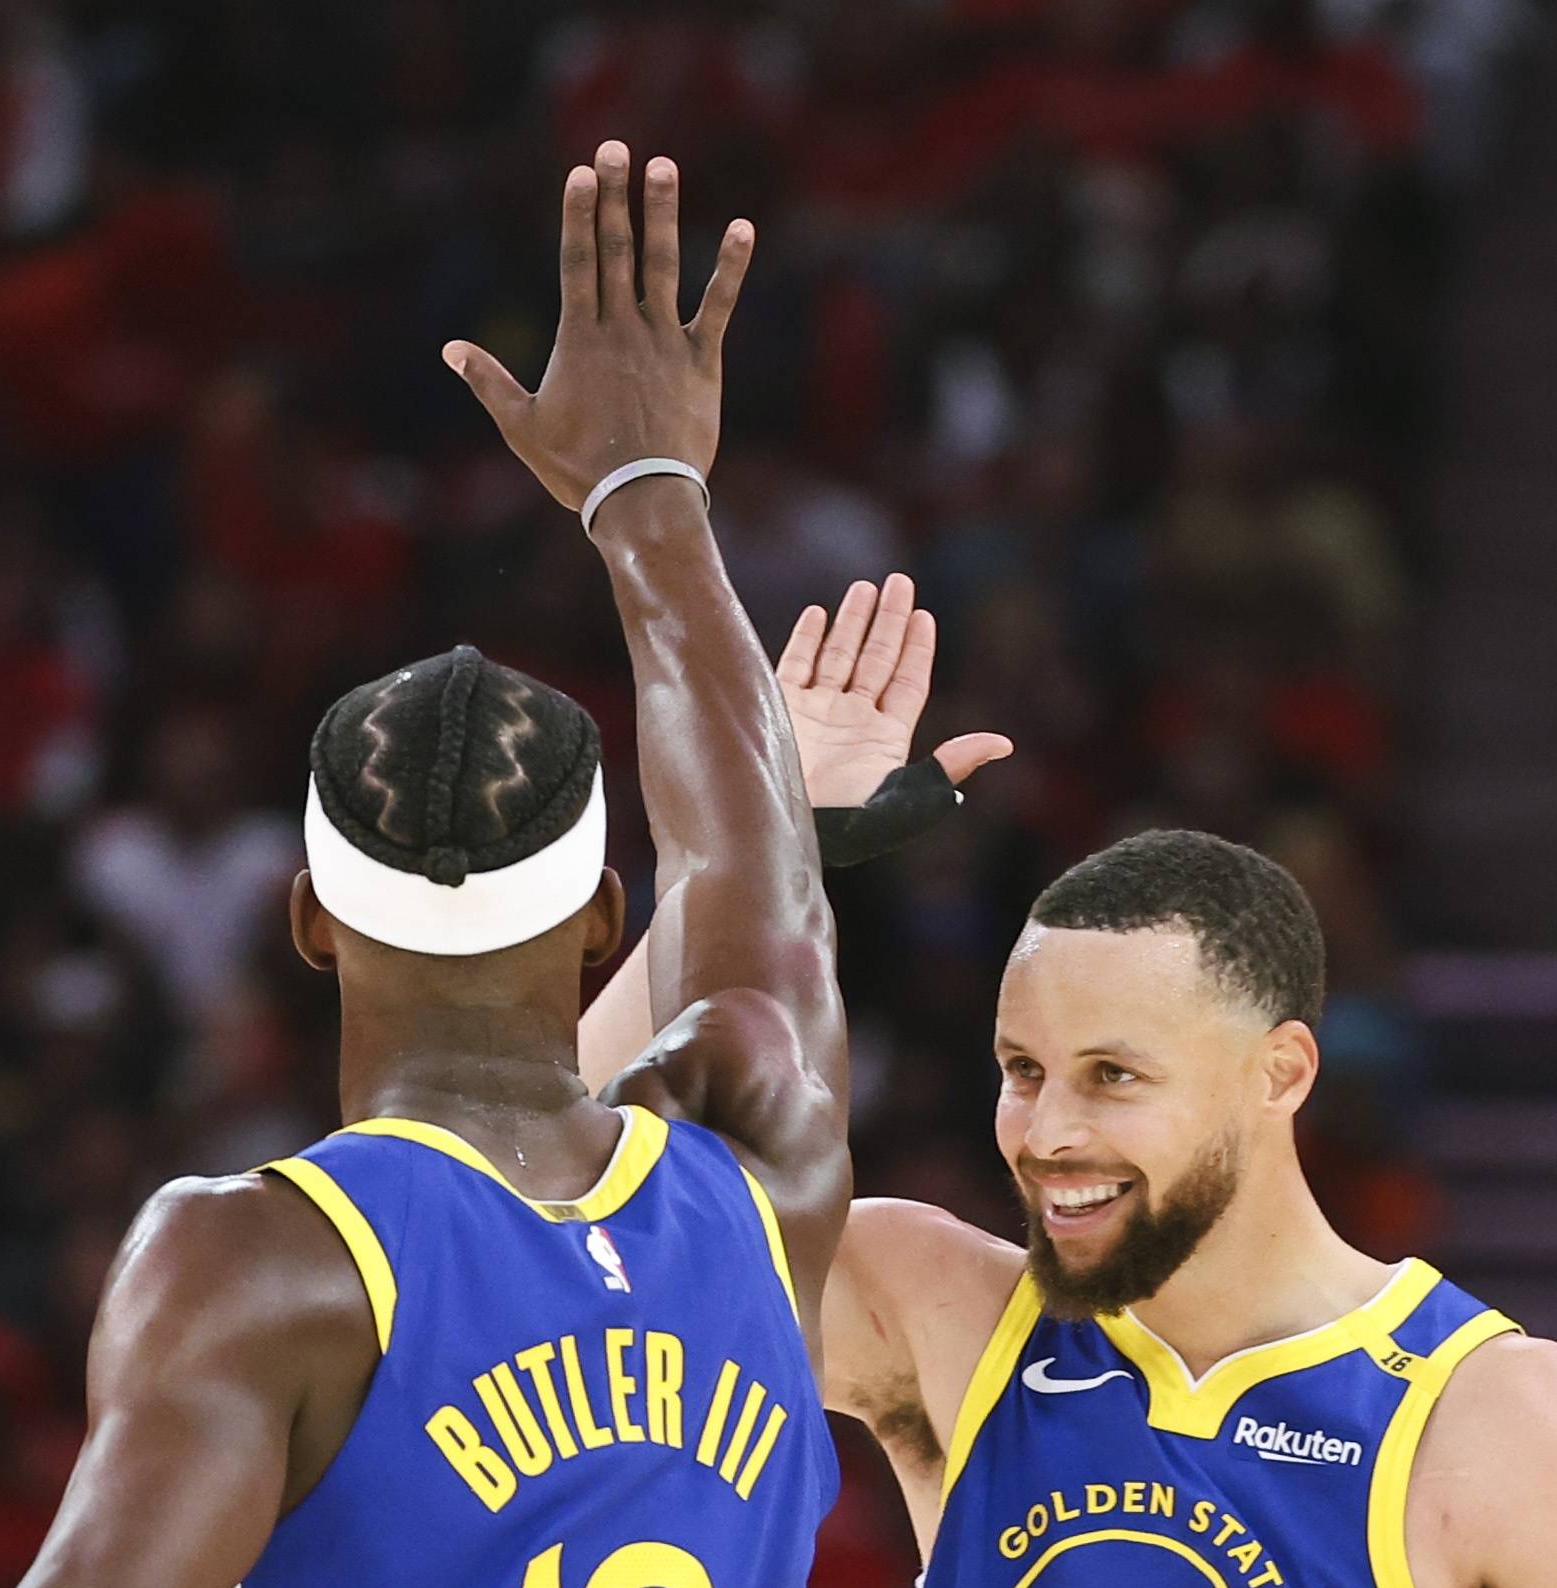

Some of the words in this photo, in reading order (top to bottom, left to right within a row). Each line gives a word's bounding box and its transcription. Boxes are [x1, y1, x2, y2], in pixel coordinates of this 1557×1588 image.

[1381, 1351, 1412, 1371] 16
[425, 1328, 685, 1512] BUTLER
[696, 1361, 788, 1501] III
[1232, 1416, 1362, 1466] Rakuten
[997, 1481, 1175, 1560] GOLDEN
